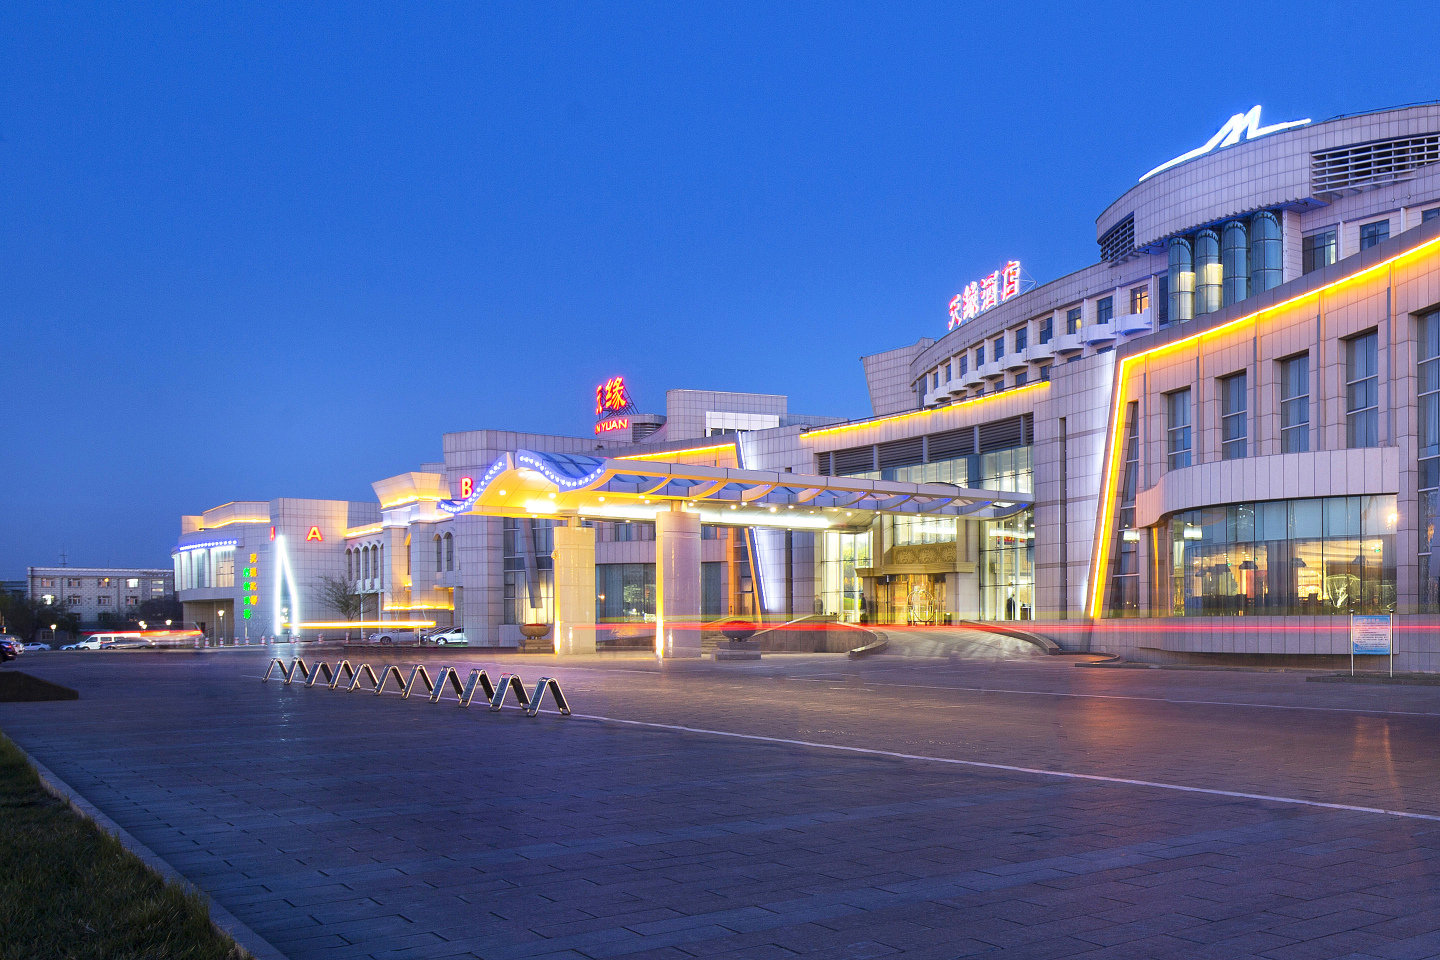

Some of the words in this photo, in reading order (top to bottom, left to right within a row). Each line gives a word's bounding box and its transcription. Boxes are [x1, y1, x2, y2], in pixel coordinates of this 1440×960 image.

[948, 260, 1020, 330] 天缘酒店
[461, 476, 474, 500] B
[306, 526, 323, 541] A
